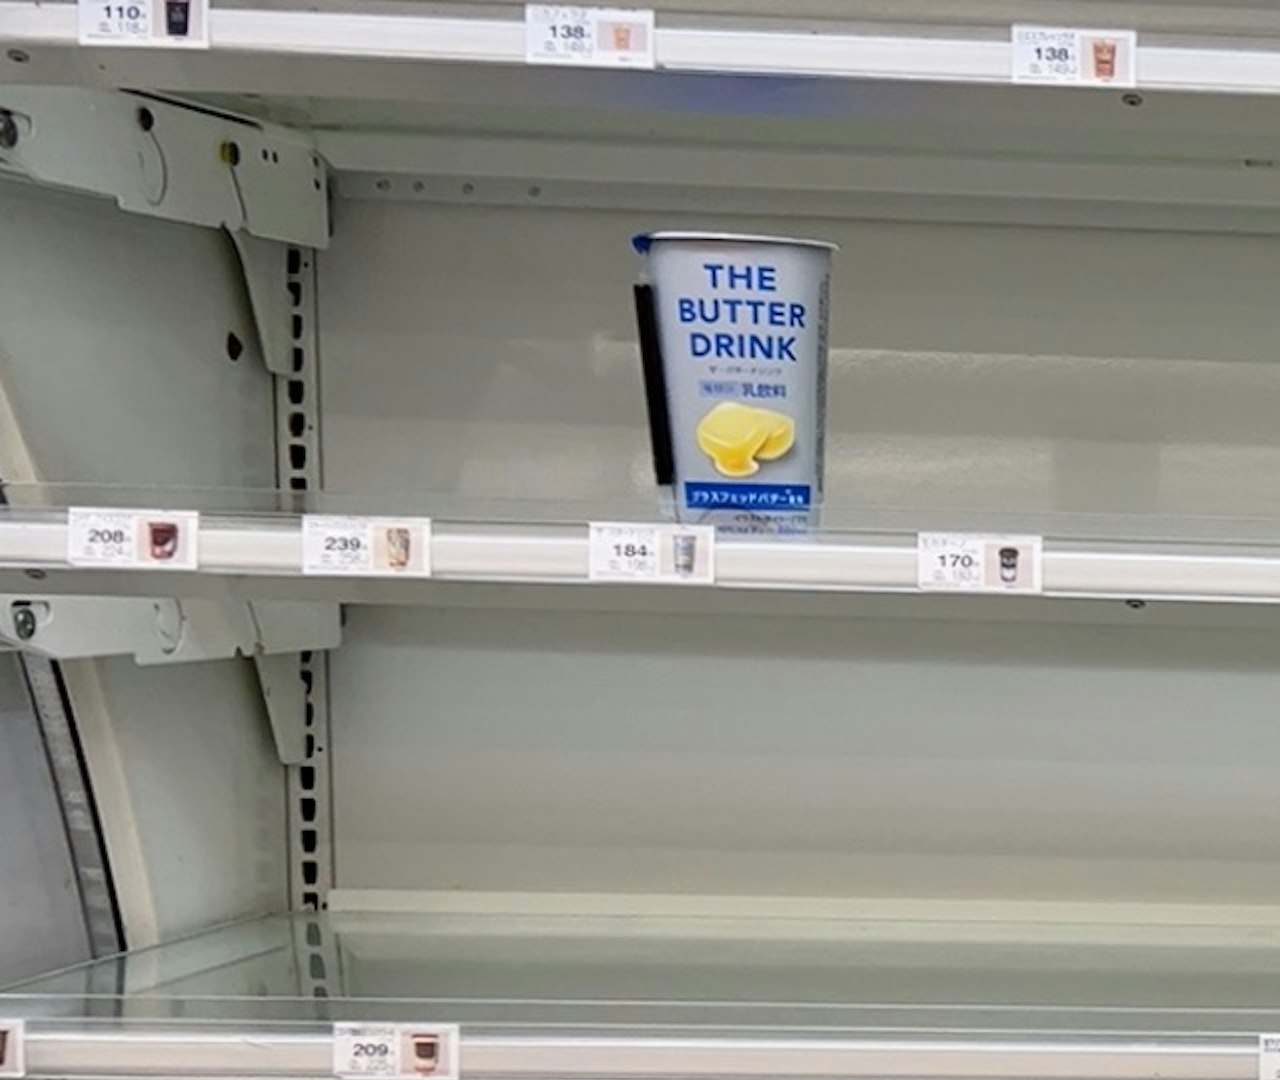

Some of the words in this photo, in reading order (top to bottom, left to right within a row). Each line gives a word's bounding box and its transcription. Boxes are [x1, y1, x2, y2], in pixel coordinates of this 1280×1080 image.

[703, 264, 777, 291] THE
[678, 298, 807, 328] BUTTER
[689, 332, 798, 361] DRINK
